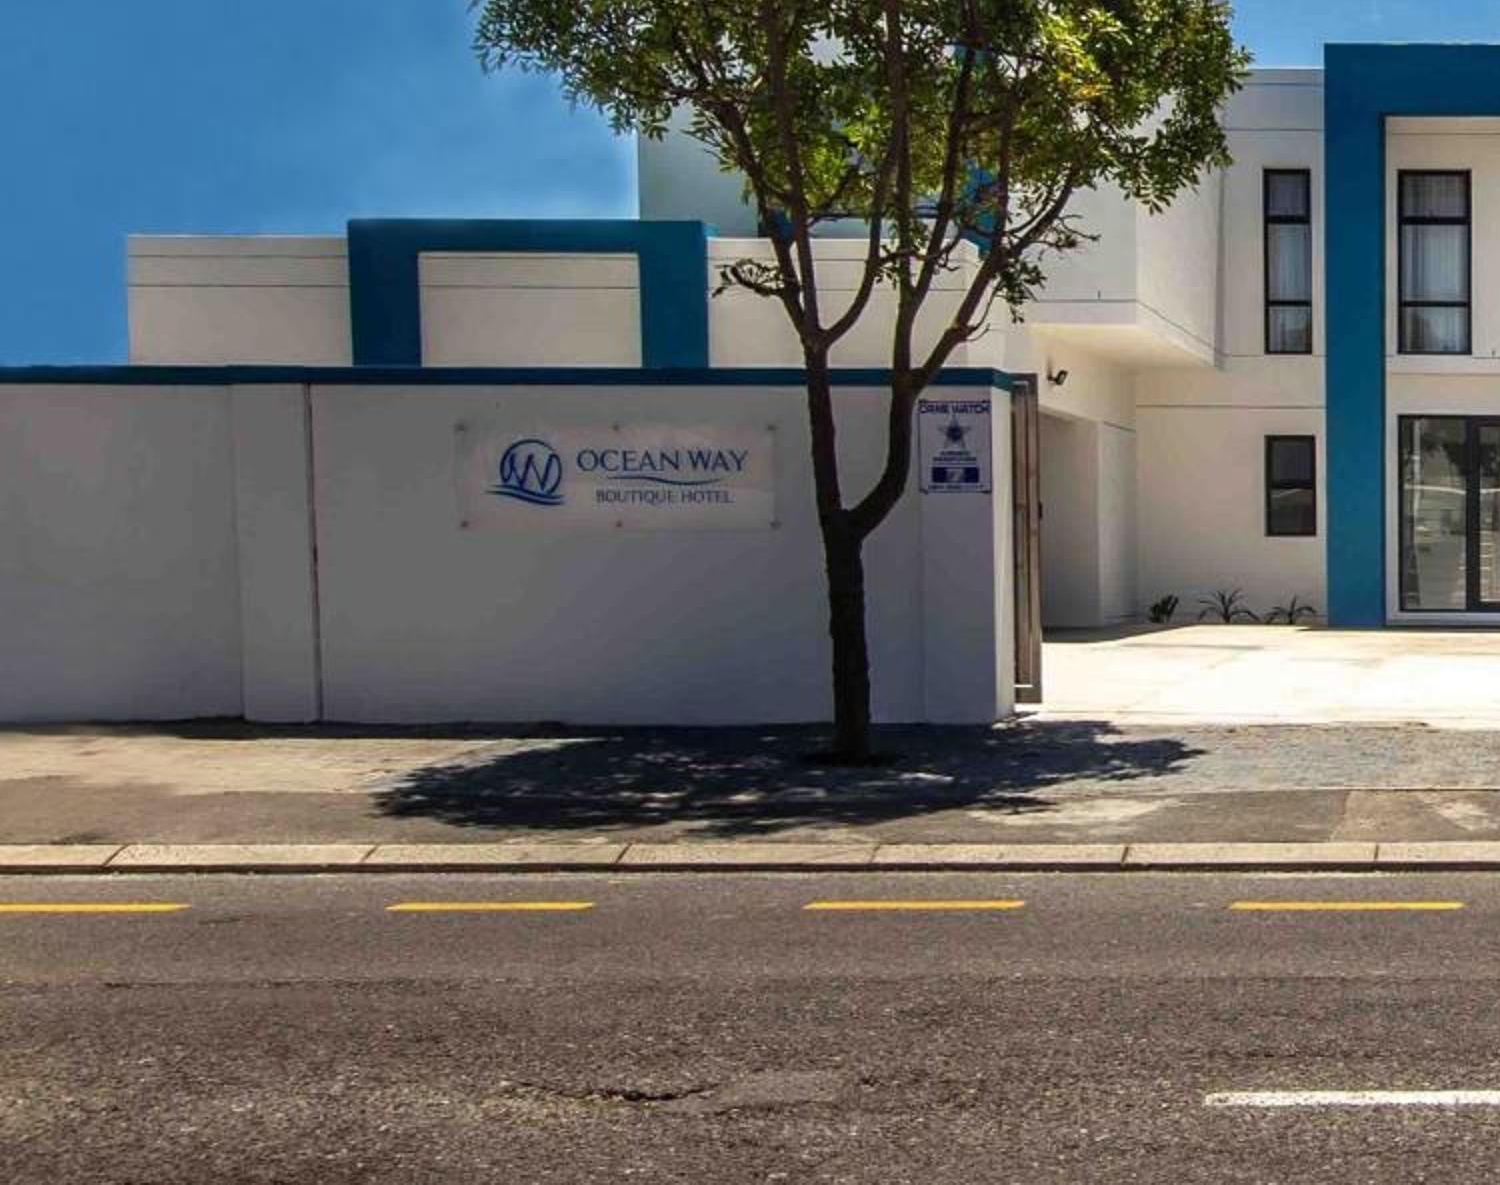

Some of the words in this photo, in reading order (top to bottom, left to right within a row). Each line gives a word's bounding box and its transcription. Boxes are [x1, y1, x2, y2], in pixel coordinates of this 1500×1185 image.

[576, 449, 680, 472] OCEAN
[686, 449, 749, 471] WAY
[595, 489, 675, 505] BOUTIQUE
[680, 489, 735, 504] HOTEL
